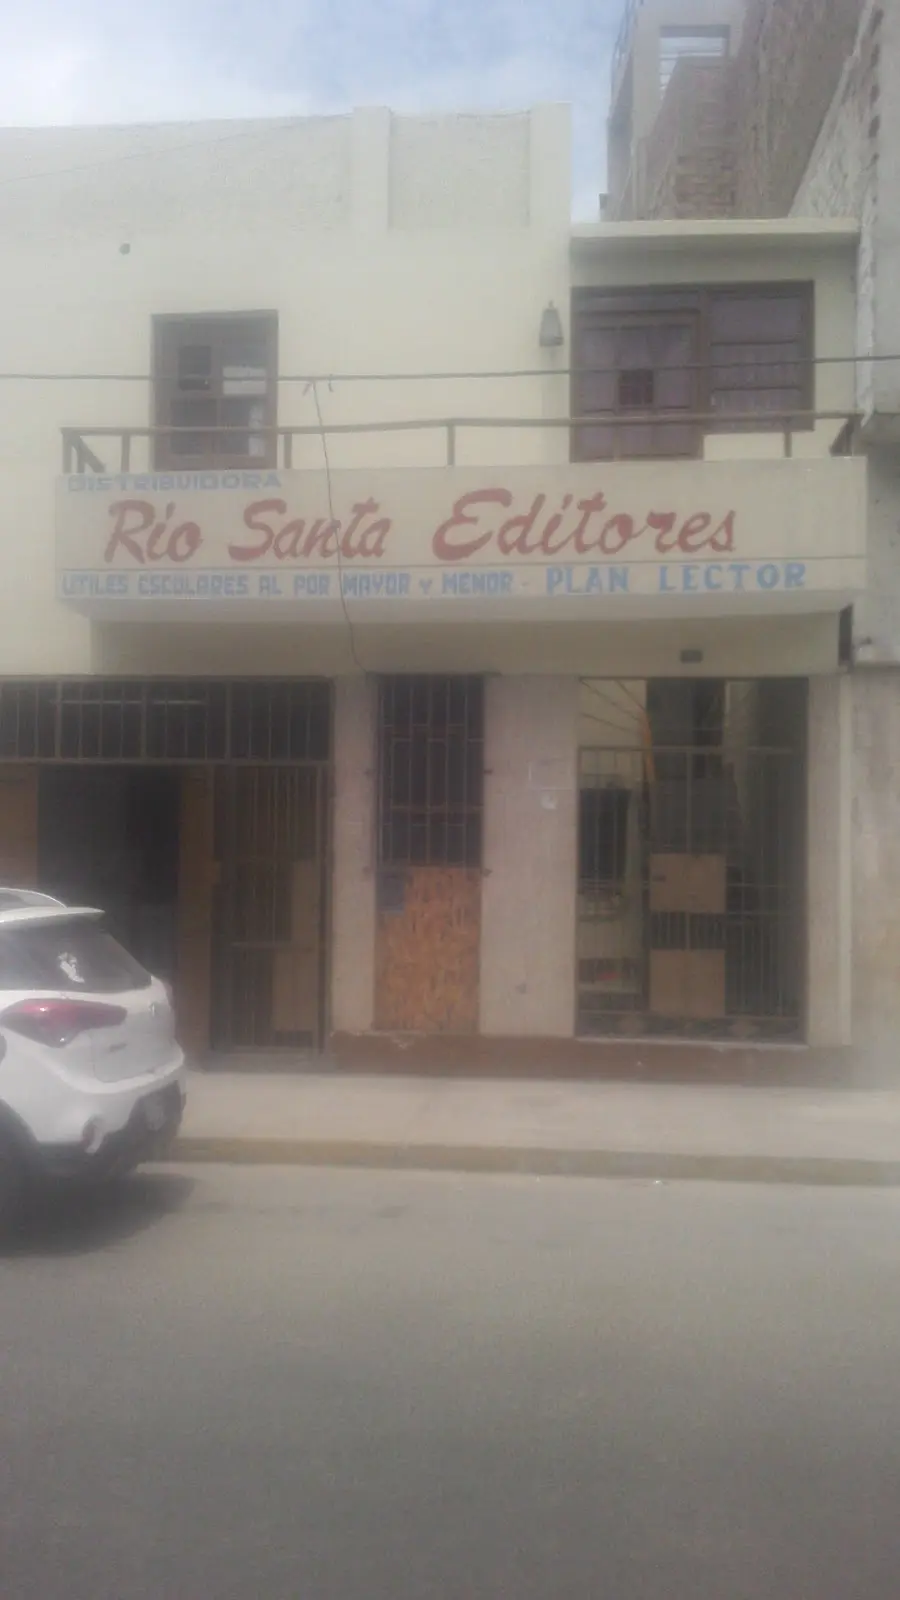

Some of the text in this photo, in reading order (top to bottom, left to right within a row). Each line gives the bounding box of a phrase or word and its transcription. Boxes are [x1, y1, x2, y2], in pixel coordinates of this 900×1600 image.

[67, 472, 281, 492] DISTRIBUIDORA
[228, 497, 391, 561] Santa
[432, 488, 735, 561] Editores
[62, 574, 128, 596] UTILES
[138, 573, 250, 596] ESCOLARES
[258, 574, 282, 595] AL
[294, 574, 329, 596] POR
[343, 572, 411, 597] MAYOR
[442, 571, 513, 595] MENOR
[546, 566, 629, 594] PLAN
[660, 563, 806, 591] LECTOR
